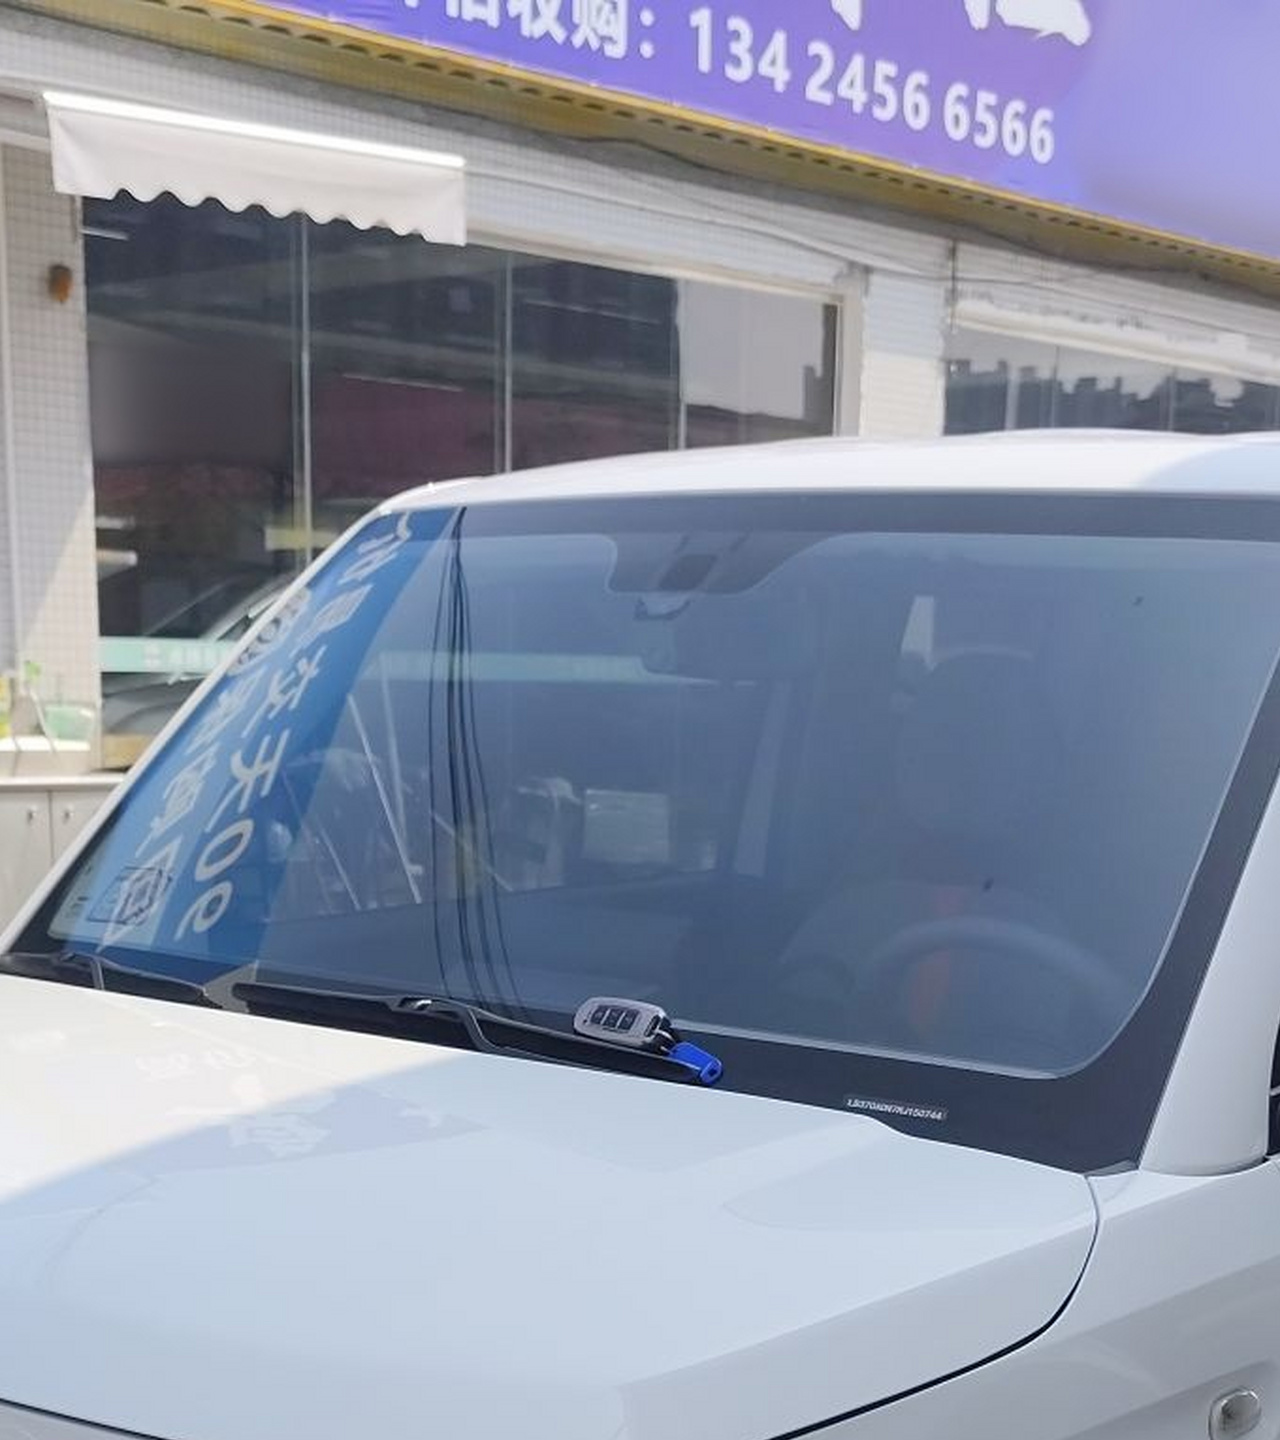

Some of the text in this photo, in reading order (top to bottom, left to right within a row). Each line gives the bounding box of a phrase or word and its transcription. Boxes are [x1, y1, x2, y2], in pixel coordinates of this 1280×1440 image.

[689, 7, 790, 93] 134
[805, 40, 931, 131] 2456
[943, 82, 1055, 164] 6566
